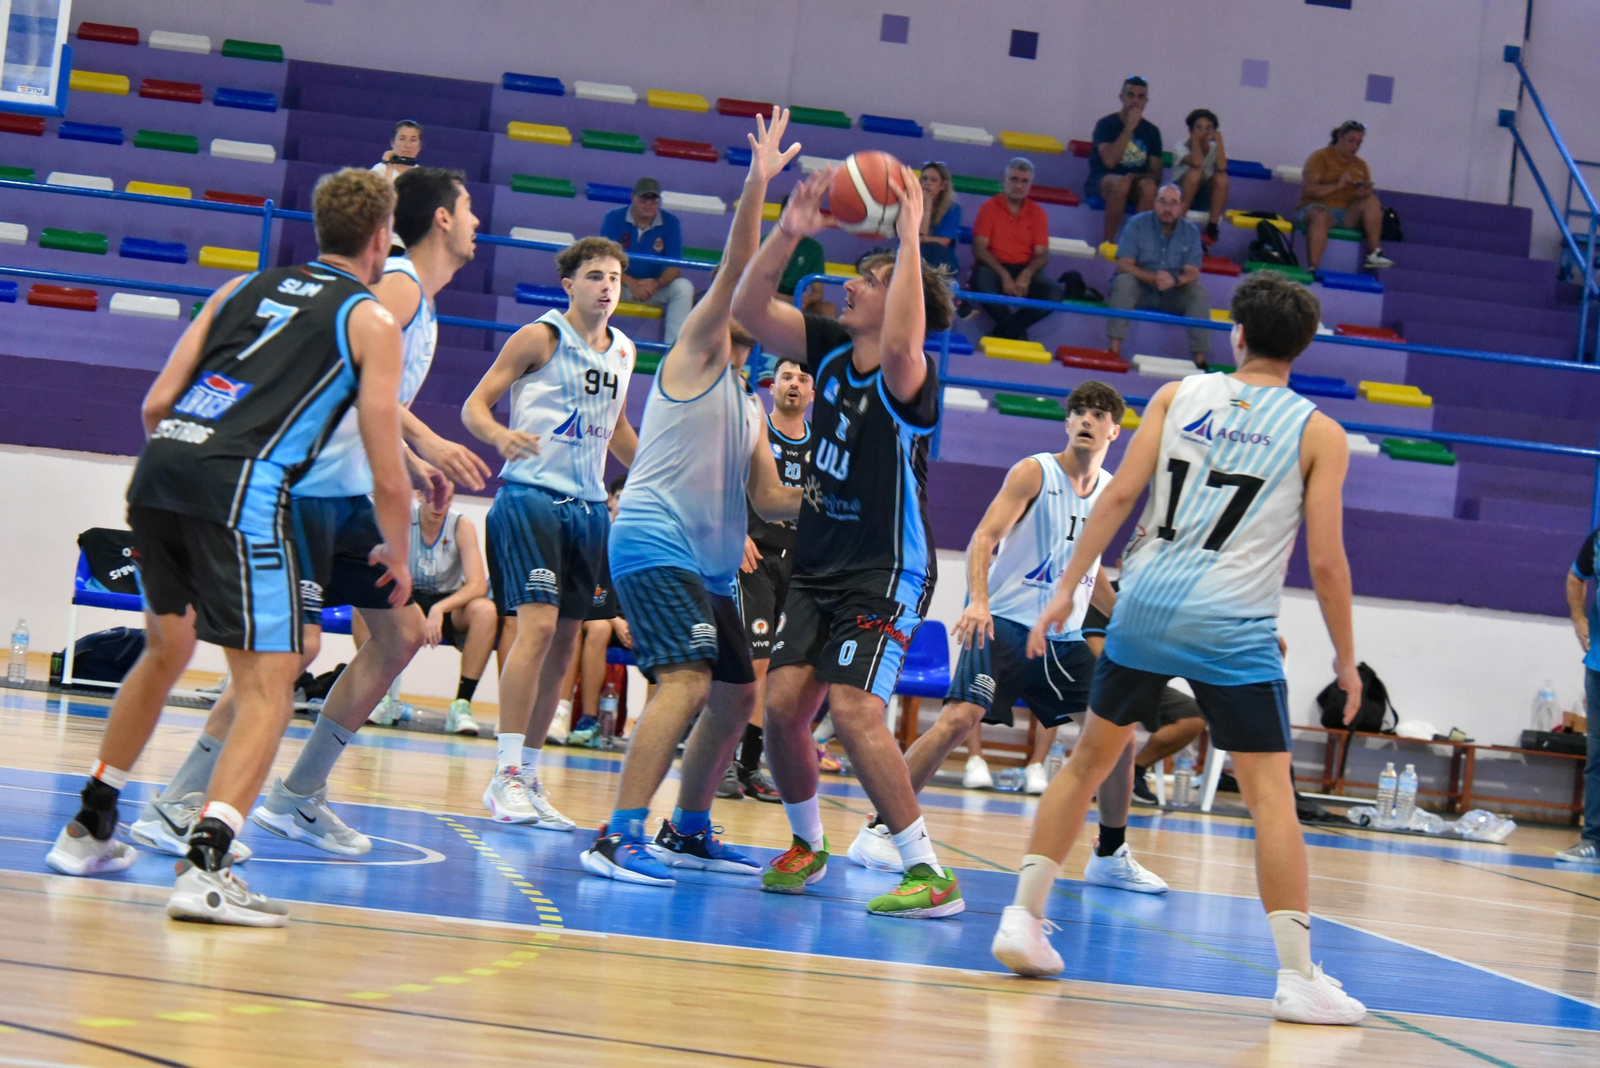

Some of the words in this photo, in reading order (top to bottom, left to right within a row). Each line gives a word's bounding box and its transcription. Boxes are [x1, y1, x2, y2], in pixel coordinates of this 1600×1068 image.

[236, 297, 300, 361] 7
[584, 368, 619, 401] 94
[1156, 457, 1266, 552] 17
[752, 640, 770, 648] vive
[838, 639, 858, 667] 0
